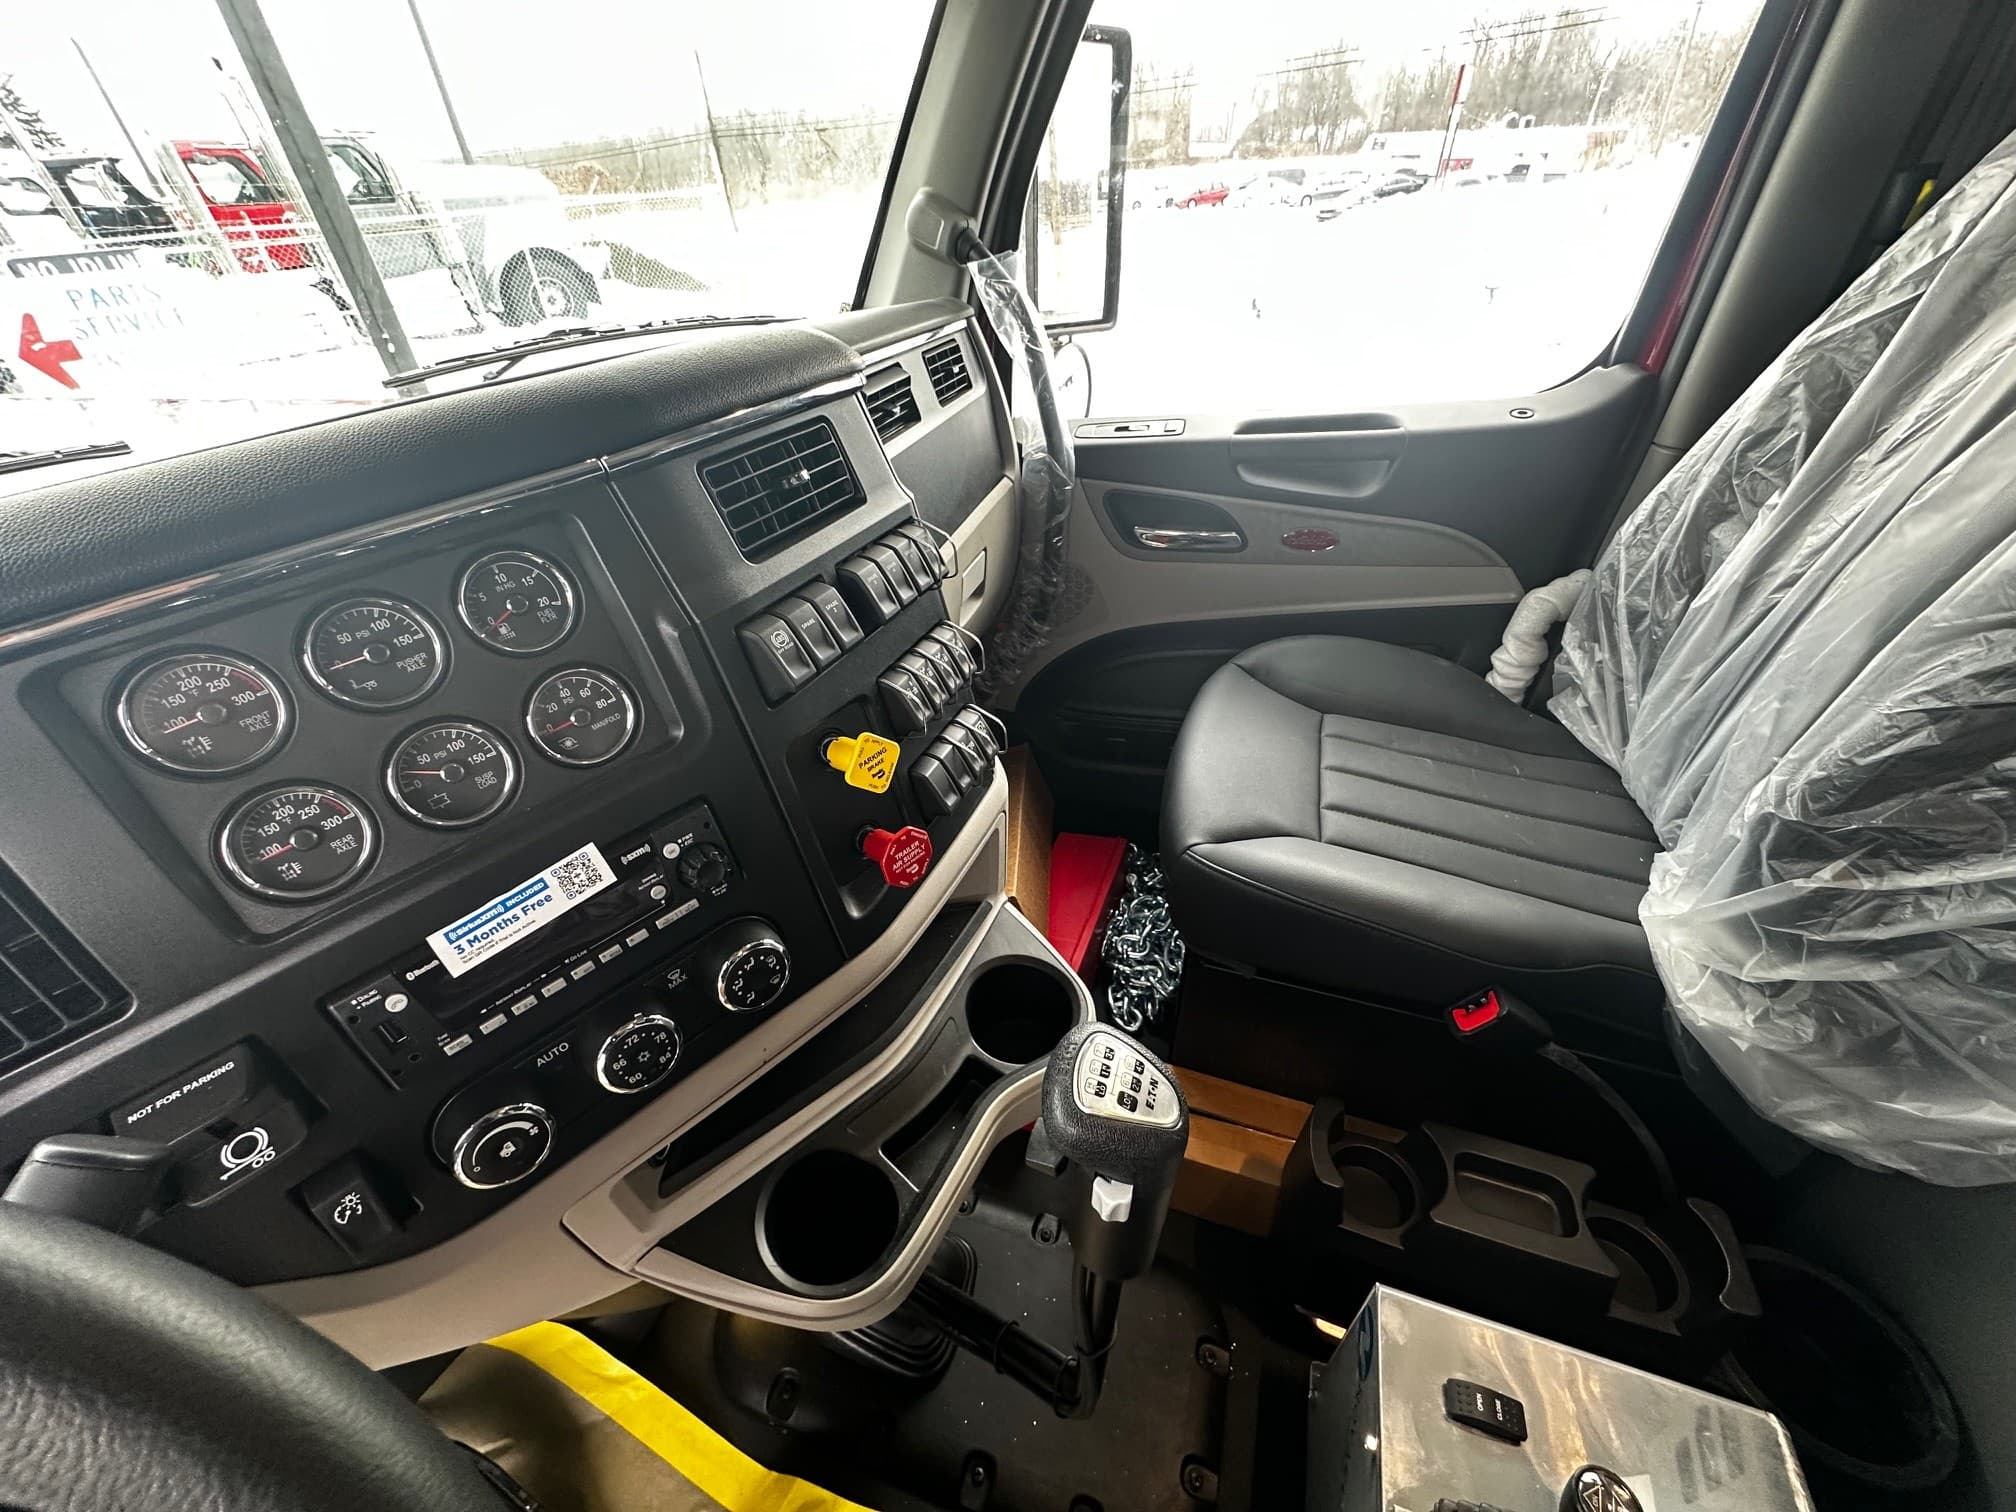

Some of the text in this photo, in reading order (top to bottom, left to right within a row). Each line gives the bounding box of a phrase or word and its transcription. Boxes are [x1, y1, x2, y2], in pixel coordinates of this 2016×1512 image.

[495, 573, 508, 584] 10
[522, 576, 534, 586] 15
[478, 592, 486, 602] 5
[538, 596, 550, 607] 20
[370, 618, 390, 632] 100
[488, 616, 495, 624] 0
[336, 632, 352, 644] 50
[355, 630, 370, 640] PSI
[394, 634, 413, 647] 150
[396, 652, 428, 669] PUSHER
[406, 662, 426, 672] AXLE
[176, 676, 202, 692] 200
[206, 677, 231, 693] 250
[232, 690, 256, 706] 300
[560, 688, 570, 698] 40
[580, 688, 591, 698] 60
[161, 693, 186, 708] 150
[596, 699, 608, 709] 80
[546, 702, 558, 713] 20
[239, 710, 270, 728] FRONT
[250, 720, 272, 733] AXLE
[446, 739, 465, 752] 100
[416, 754, 430, 764] 50
[434, 750, 448, 760] PSI
[468, 752, 486, 765] 150
[858, 746, 887, 769] PARKING
[866, 758, 884, 772] BRAKE
[272, 804, 295, 820] 200
[298, 804, 320, 820] 250
[258, 822, 280, 837] 150
[321, 816, 342, 831] 300
[330, 834, 354, 849] REAR
[260, 843, 282, 858] 100
[336, 842, 358, 855] AXLE
[894, 840, 920, 861] TRAILER
[892, 860, 903, 871] AIR
[904, 843, 926, 864] SUPPLY
[506, 882, 546, 907] INCLUDED
[454, 894, 553, 955] 3 Months Free
[668, 974, 688, 990] MAX
[627, 1034, 640, 1047] 72
[654, 1032, 667, 1044] 78
[536, 1042, 570, 1068] AUTO
[659, 1052, 672, 1064] 84
[612, 1058, 627, 1070] 66
[628, 1072, 643, 1084] 60
[128, 1061, 235, 1124] NOT FOR PARKING
[1476, 1392, 1484, 1412] OPEN
[1495, 1398, 1504, 1421] CLOSE
